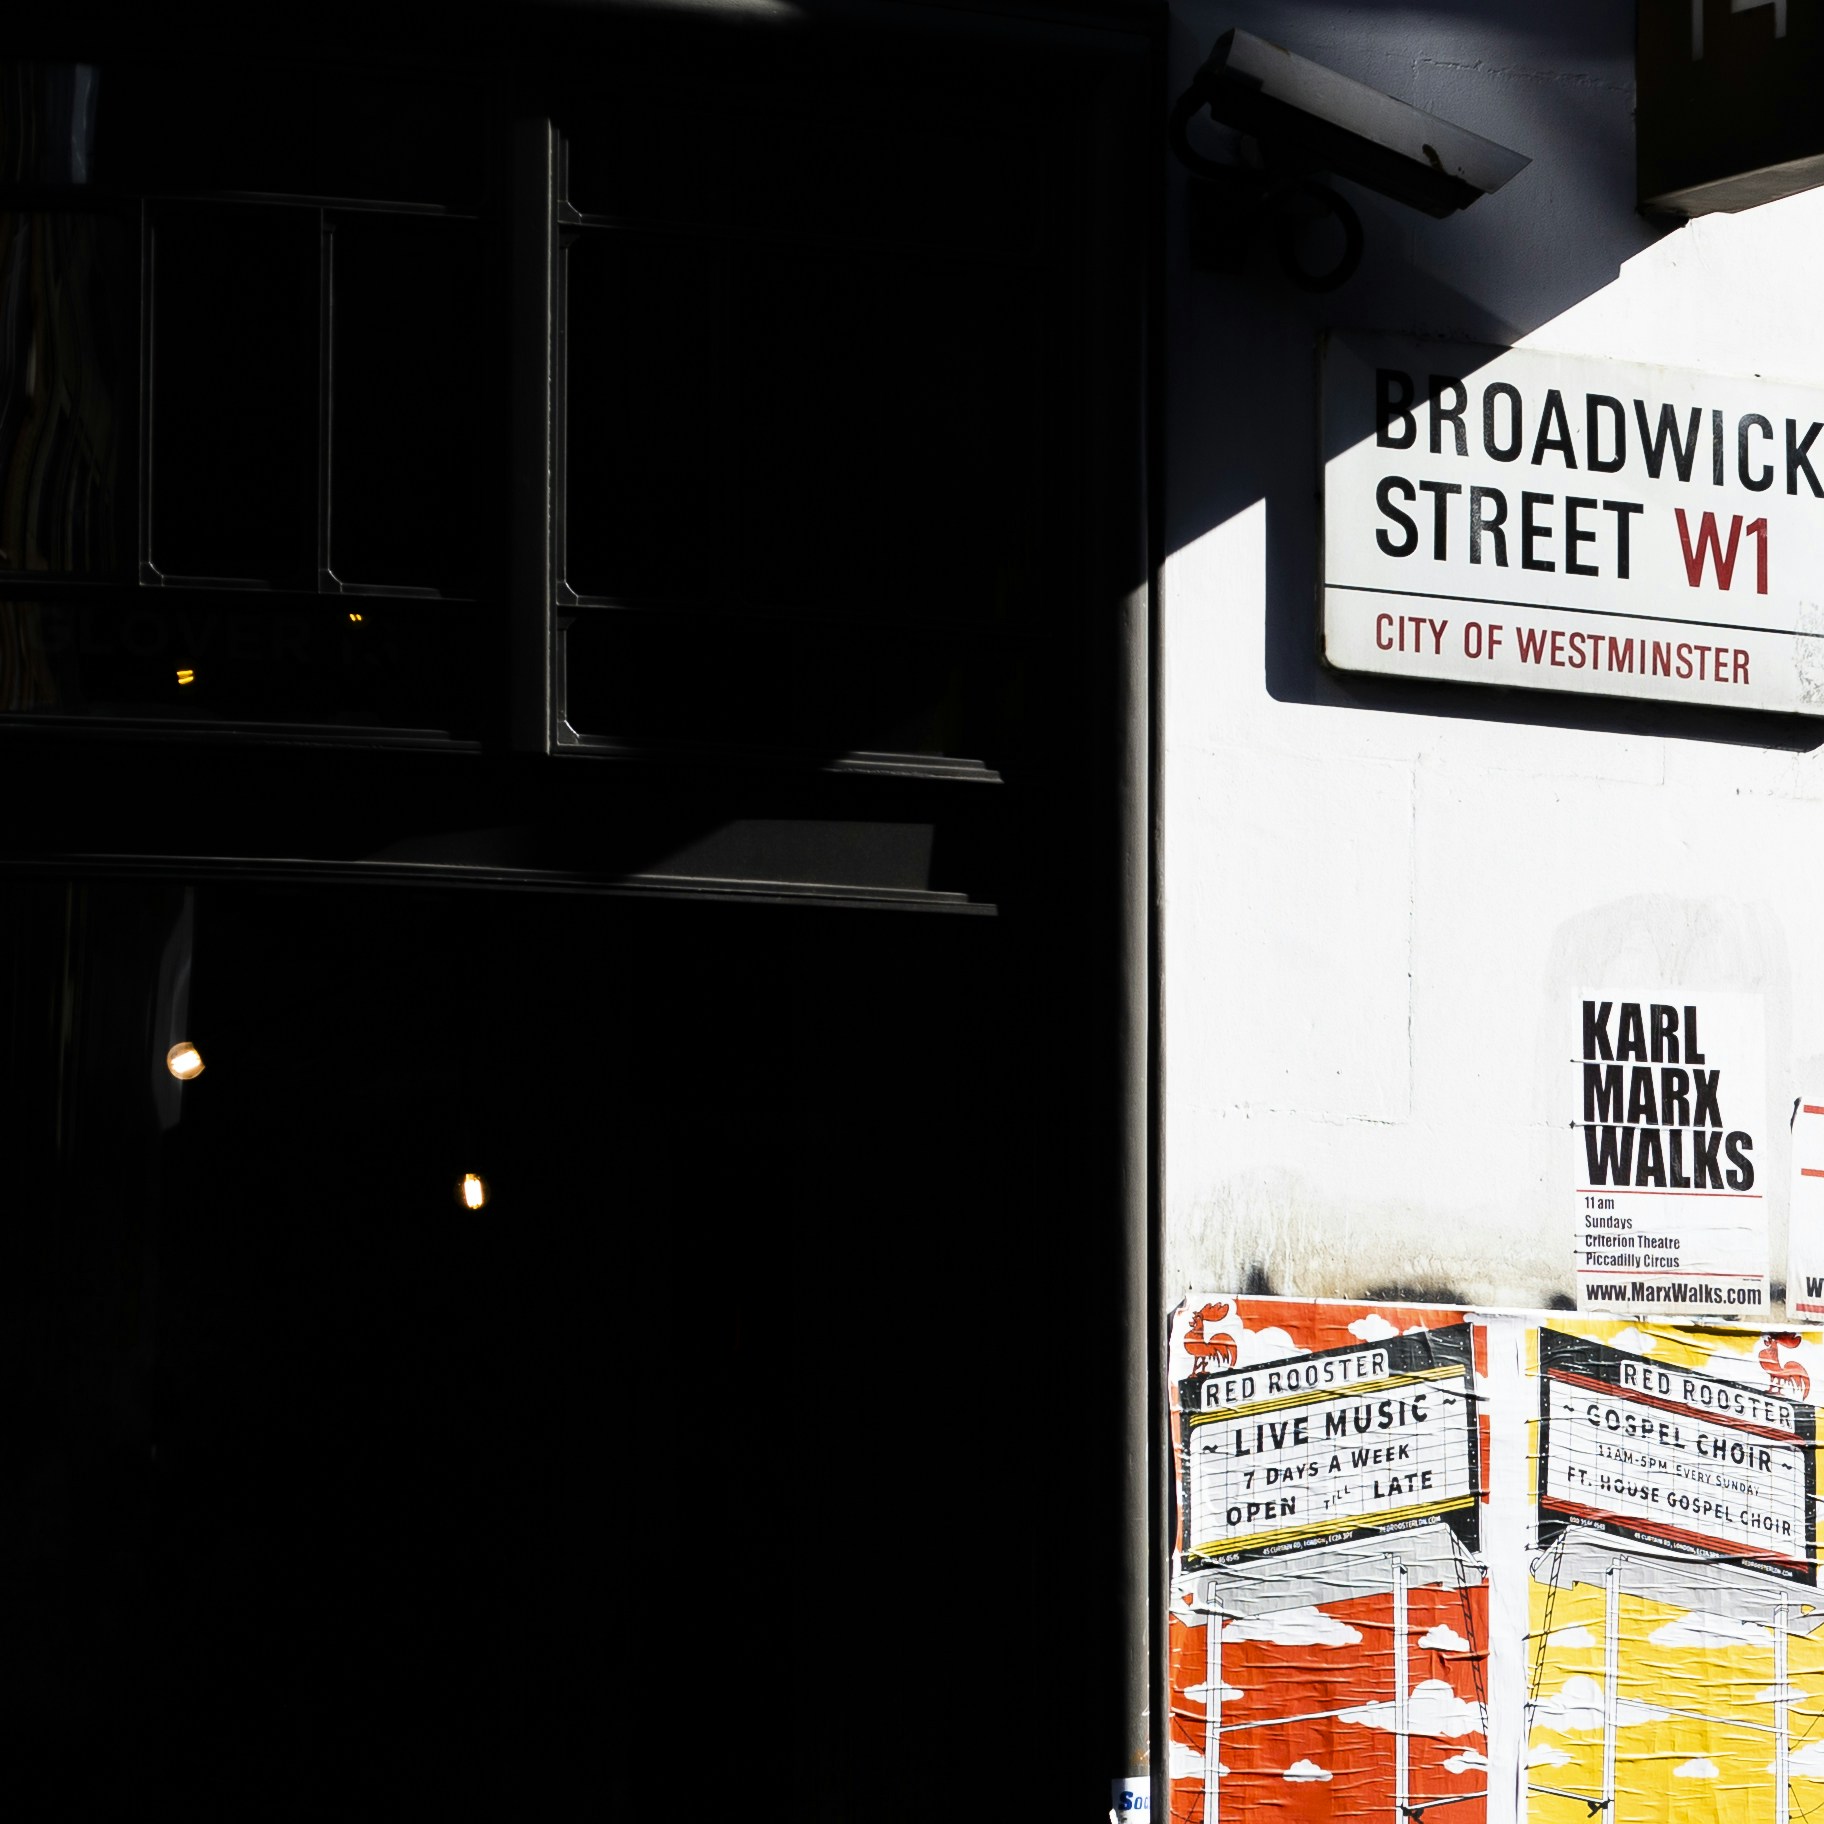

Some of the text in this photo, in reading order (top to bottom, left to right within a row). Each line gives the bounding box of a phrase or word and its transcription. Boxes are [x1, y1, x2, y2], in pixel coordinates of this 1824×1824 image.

[1375, 476, 1770, 596] STREET W1
[1376, 613, 1751, 686] CITY OF WESTMINSTER
[1582, 1000, 1705, 1065] KARL
[1582, 1064, 1723, 1128] MARX
[1582, 1125, 1755, 1191] WALKS
[1585, 1196, 1615, 1210] 11 am
[1585, 1215, 1633, 1230] Sundays
[1585, 1234, 1681, 1250] Criterion Theatre
[1586, 1252, 1680, 1269] Piccadilly Circus
[1586, 1281, 1762, 1305] www.MarxWalks.com
[1205, 1351, 1386, 1409] RED ROOSTER
[1623, 1363, 1792, 1428] RED ROOSTER
[1234, 1393, 1429, 1457] LIVE MUSIC
[1586, 1403, 1773, 1473] GOSPEL CHOIR
[1243, 1443, 1411, 1490] 7 DAYS A WEEK
[1598, 1444, 1761, 1497] 11AM-5PM EVERY SUNDAY
[1226, 1469, 1433, 1527] OPEN TILL LATE
[1566, 1465, 1792, 1537] FT. HOUSE GOSPEL CHOIR
